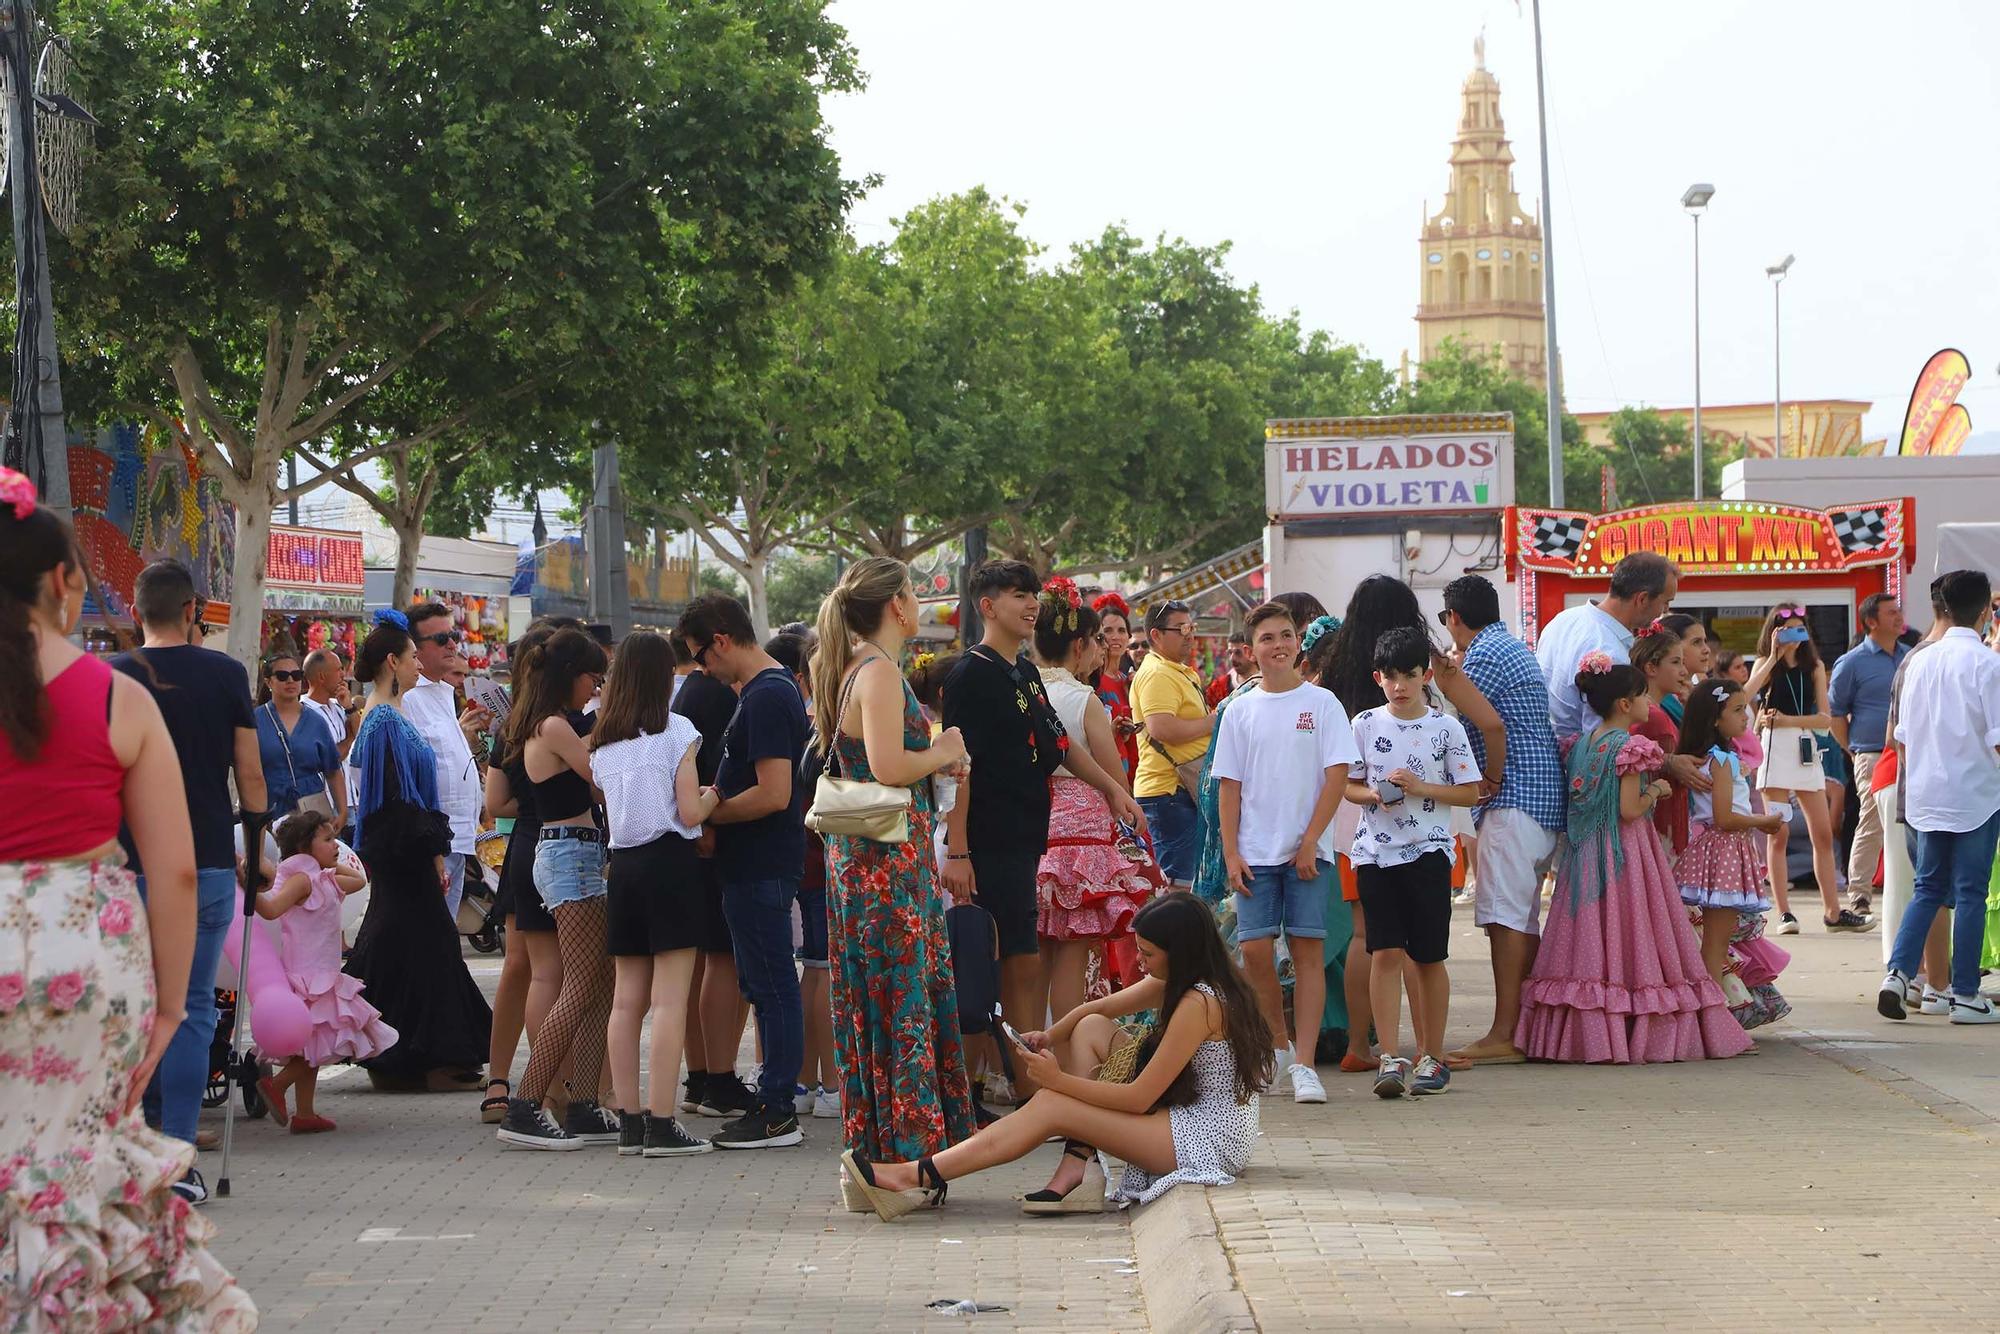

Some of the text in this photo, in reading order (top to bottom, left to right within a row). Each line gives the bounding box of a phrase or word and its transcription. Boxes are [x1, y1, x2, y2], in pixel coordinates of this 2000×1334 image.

[1285, 441, 1494, 472] HELADOS
[1308, 480, 1472, 507] VIOLETA
[1600, 515, 1820, 565] GIGANT XXL
